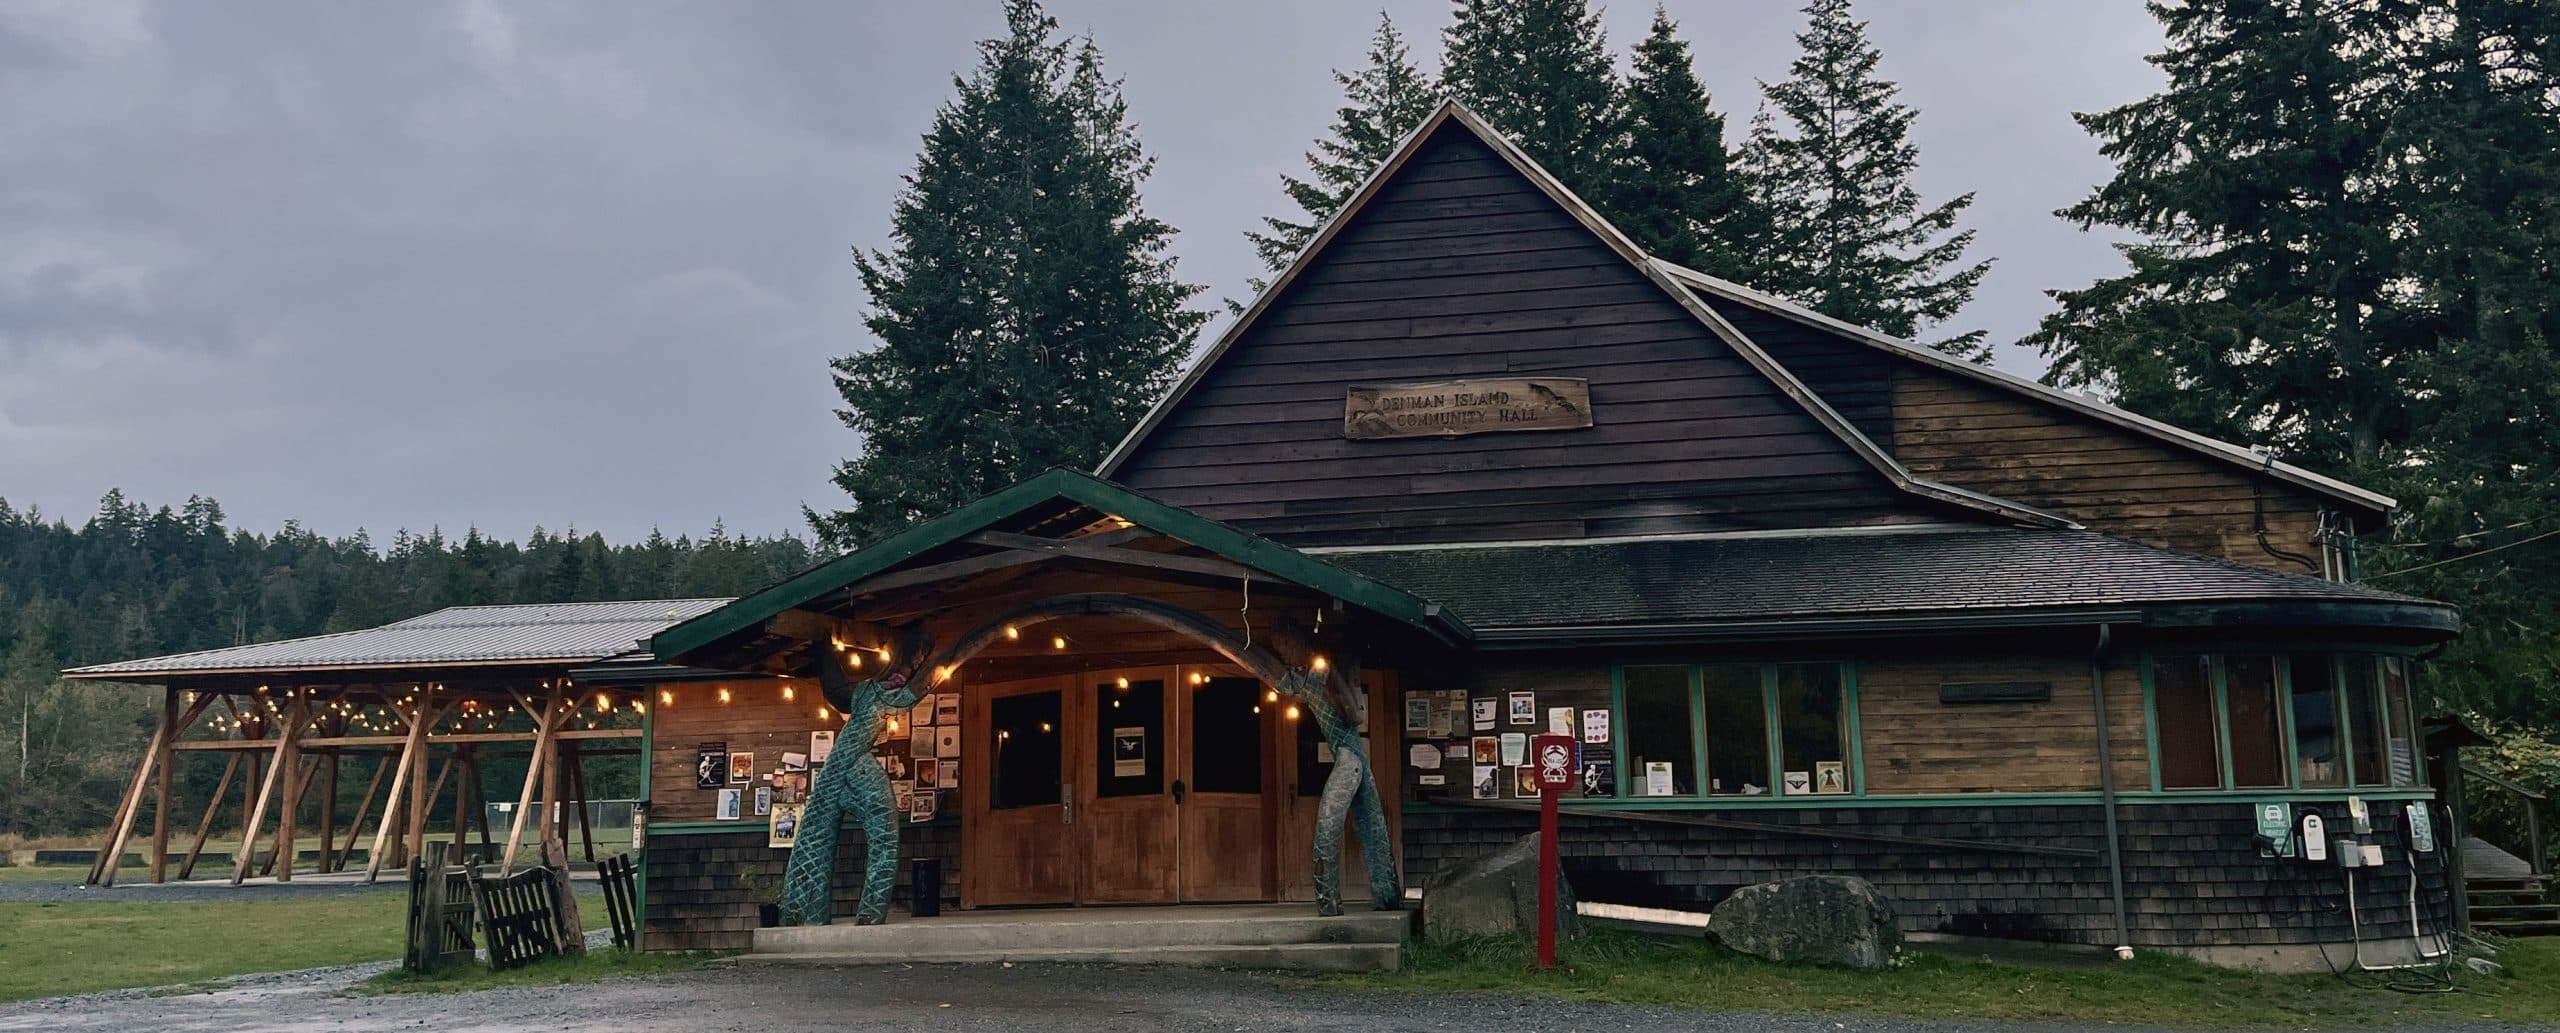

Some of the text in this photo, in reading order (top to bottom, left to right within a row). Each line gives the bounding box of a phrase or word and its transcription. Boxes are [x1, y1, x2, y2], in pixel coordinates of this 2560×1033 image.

[1382, 391, 1509, 411] DENMAN ISLAND
[1397, 408, 1538, 427] COMMUNITY HALL
